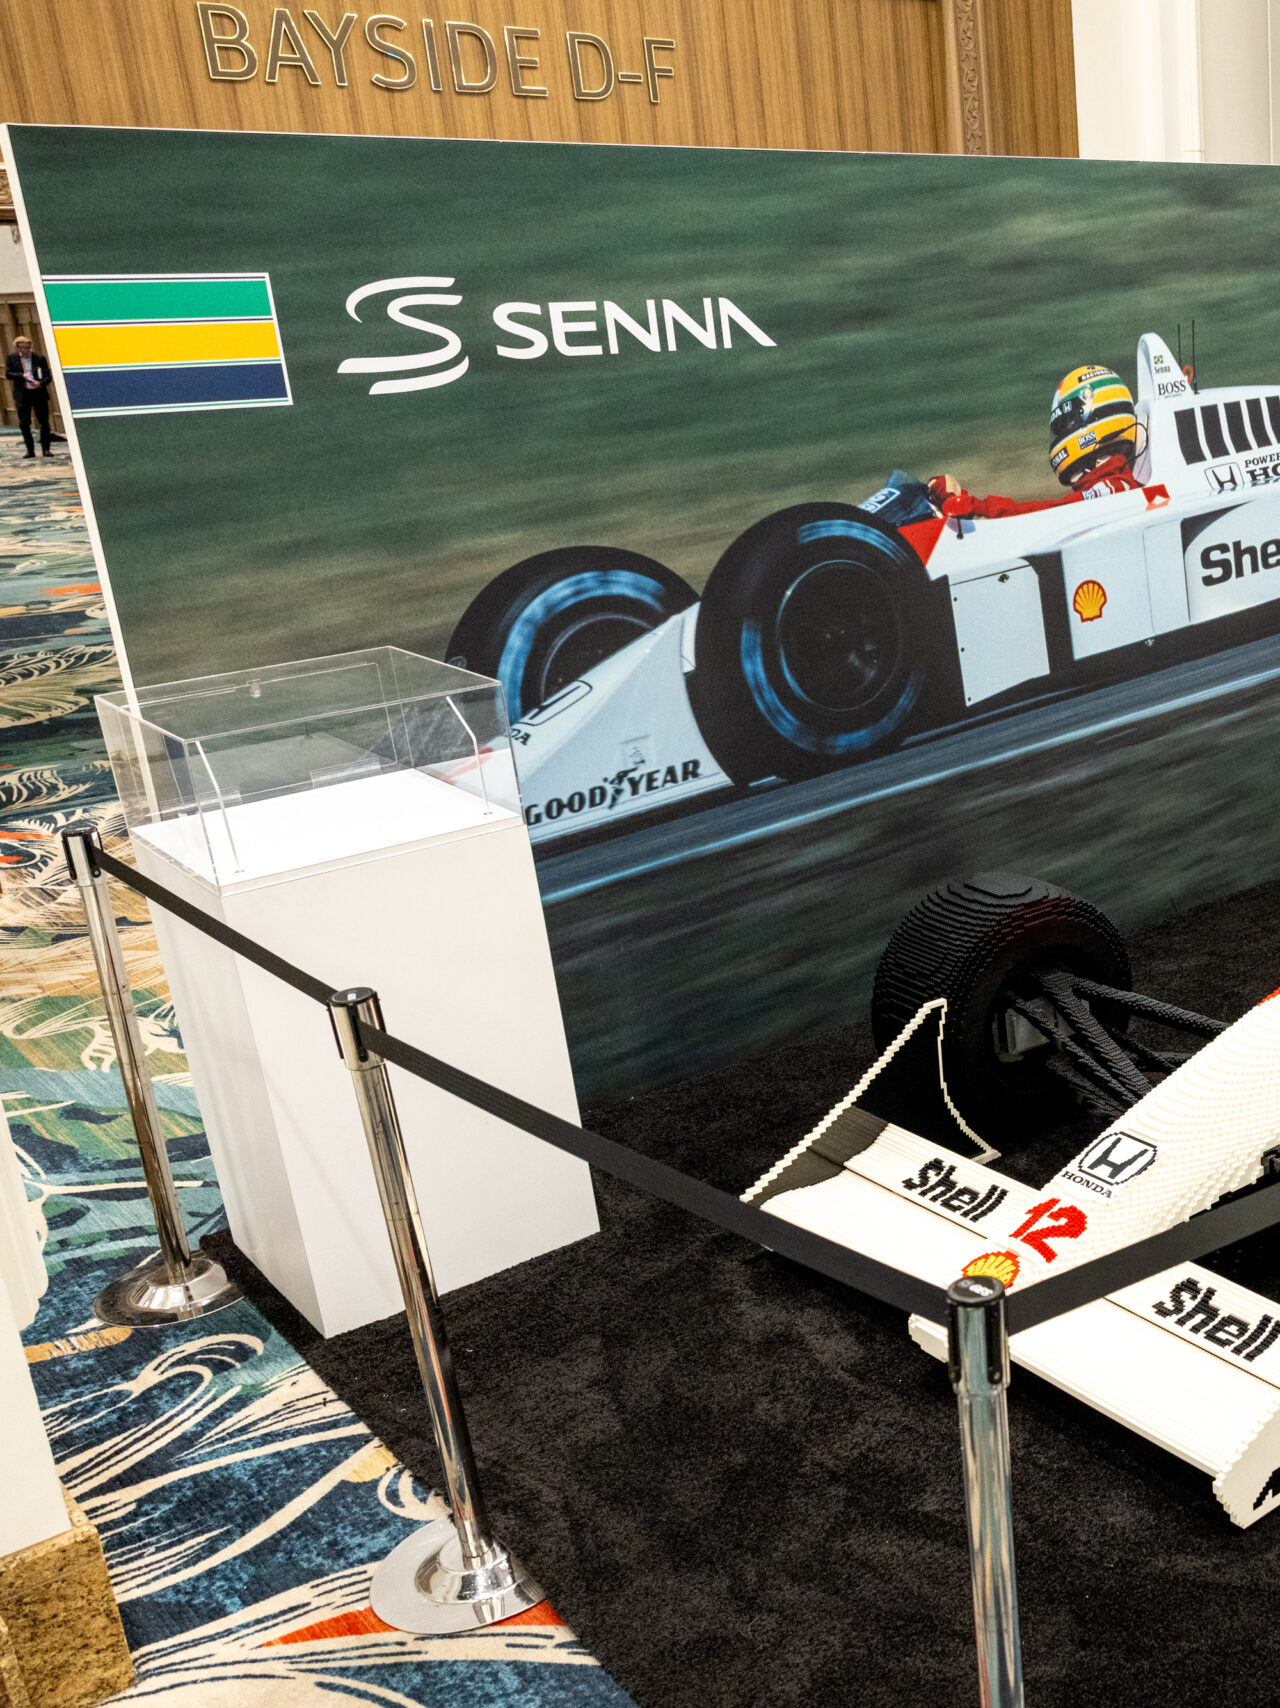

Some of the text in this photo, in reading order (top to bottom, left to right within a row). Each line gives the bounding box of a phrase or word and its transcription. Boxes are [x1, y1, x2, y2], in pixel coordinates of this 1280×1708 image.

[198, 2, 675, 104] BAYSIDE D-F
[492, 297, 778, 360] SENNA
[1158, 380, 1186, 396] BOSS
[902, 1157, 1009, 1223] Shell
[1061, 1171, 1113, 1199] HONDA
[1009, 1198, 1089, 1263] 12
